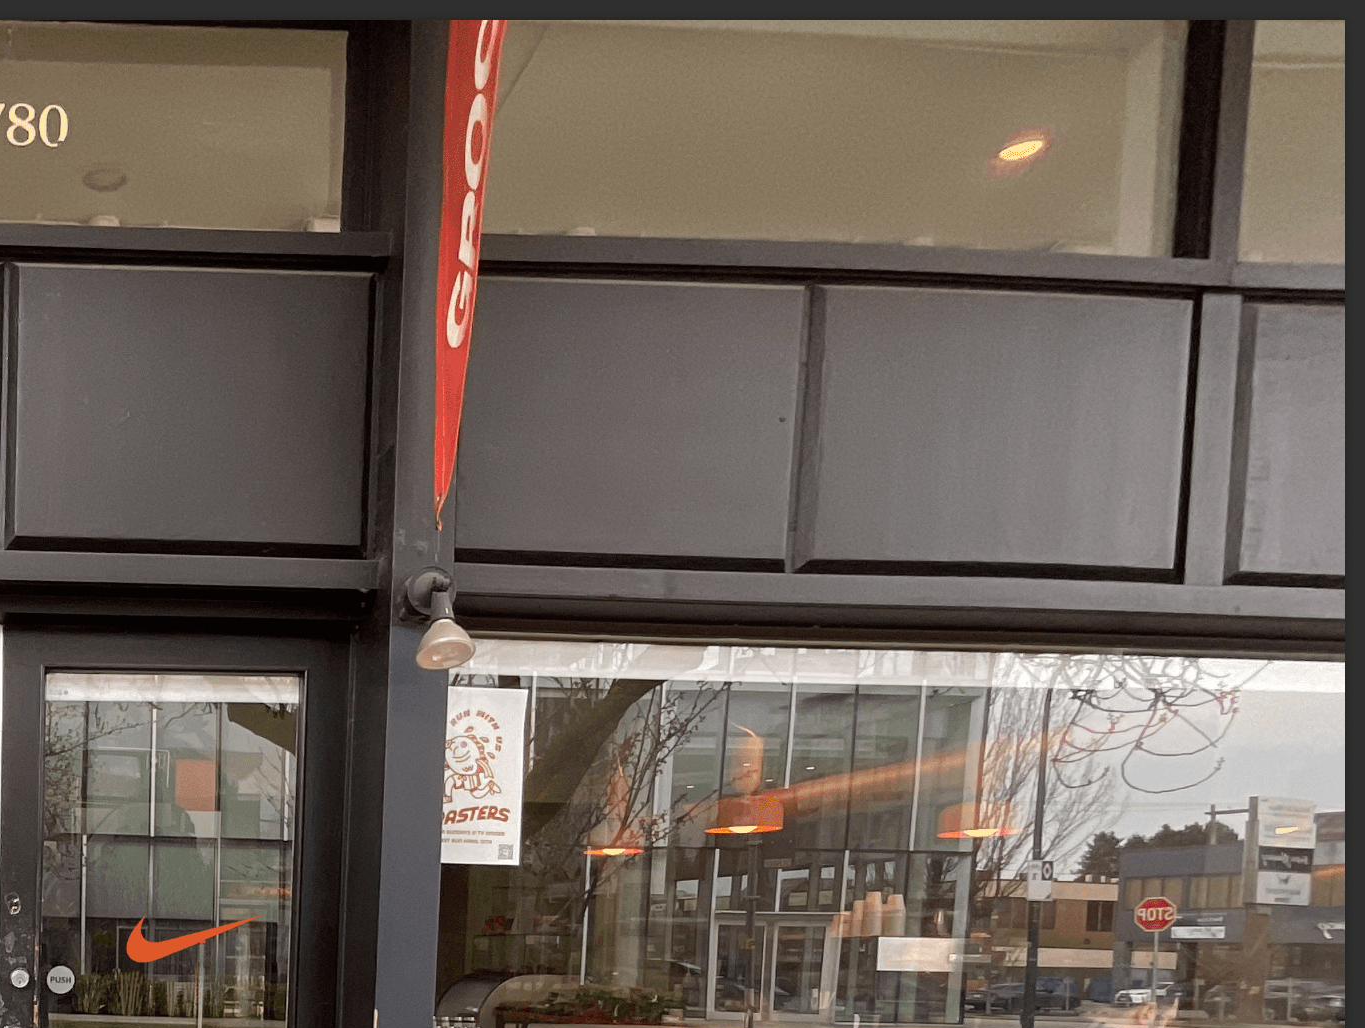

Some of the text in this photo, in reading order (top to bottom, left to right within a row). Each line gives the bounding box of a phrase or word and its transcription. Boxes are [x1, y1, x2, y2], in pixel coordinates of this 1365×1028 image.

[450, 709, 503, 752] RUN WITH US
[442, 805, 511, 825] ASTERS
[49, 975, 73, 984] PUSH
